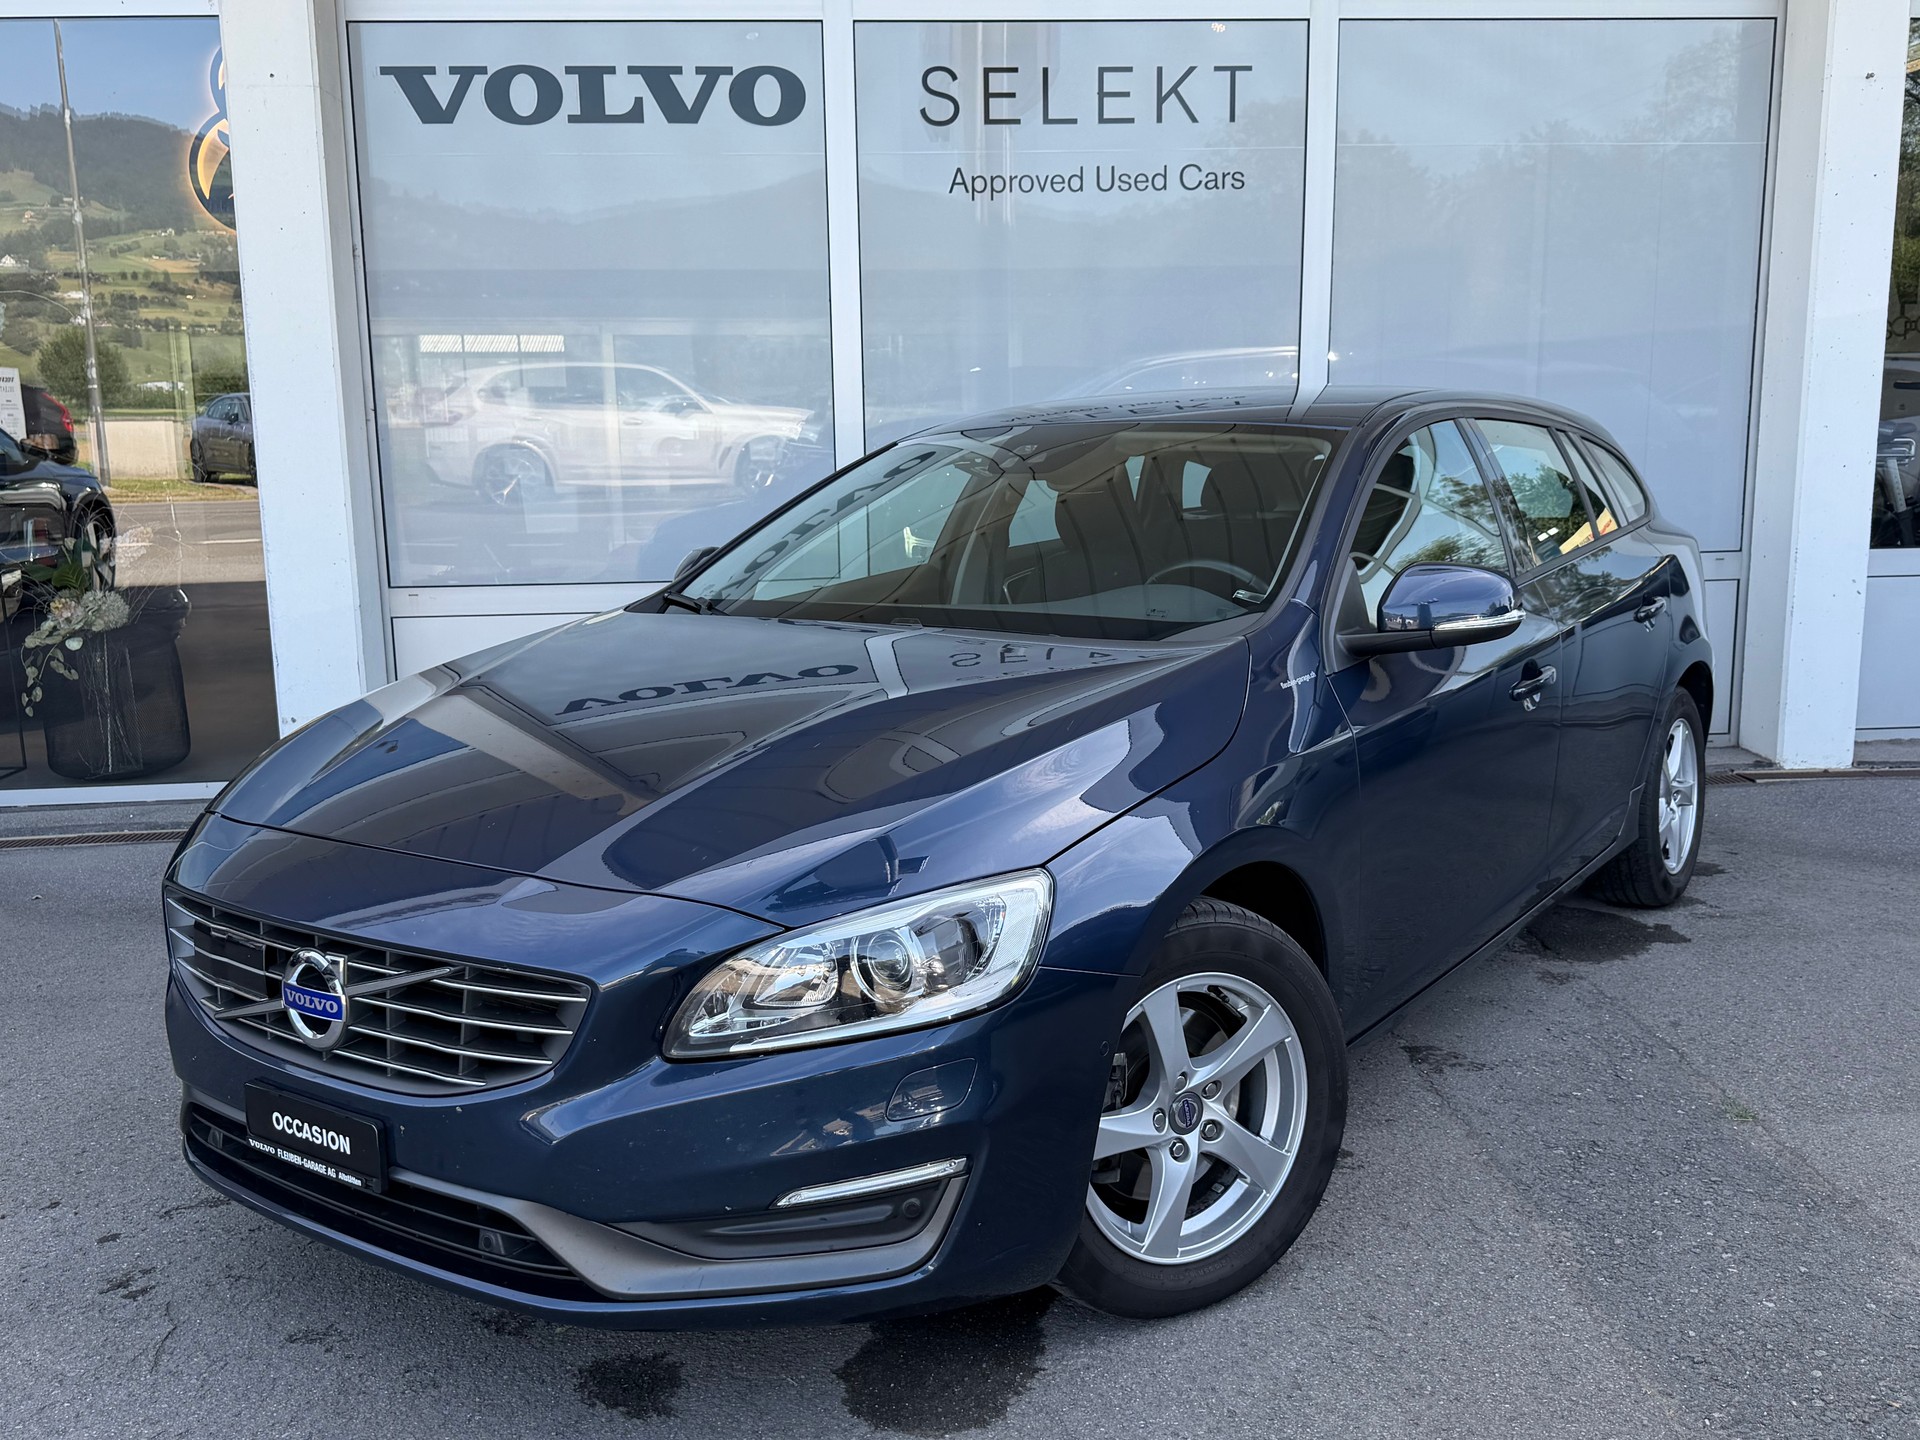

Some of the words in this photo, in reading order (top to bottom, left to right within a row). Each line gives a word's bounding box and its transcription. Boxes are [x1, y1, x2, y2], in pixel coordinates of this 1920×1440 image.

[379, 64, 807, 126] VOLVO
[919, 65, 1253, 127] SELEKT
[948, 165, 1084, 202] Approved
[1096, 165, 1168, 192] Used
[1179, 163, 1246, 191] Cars
[285, 988, 339, 1014] VOLVO
[272, 1111, 351, 1155] OCCASION
[248, 1138, 276, 1154] VOLVO
[327, 1167, 337, 1179] AG
